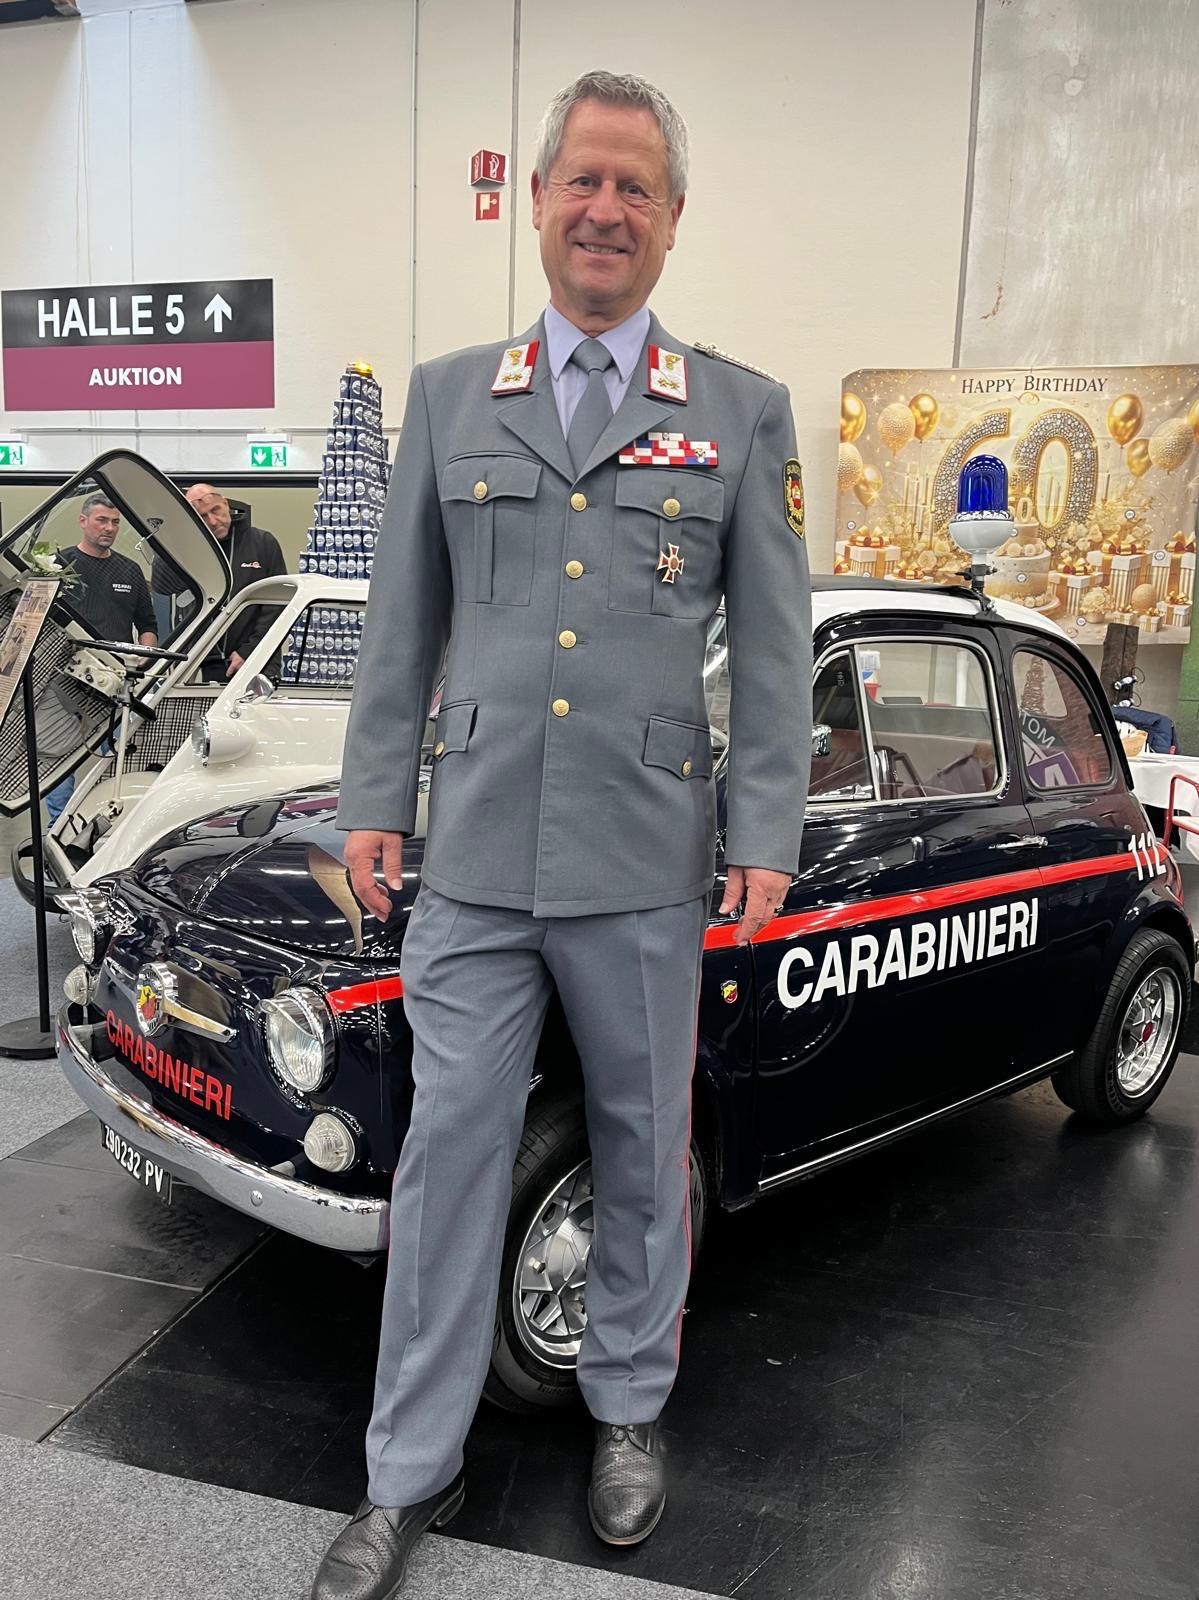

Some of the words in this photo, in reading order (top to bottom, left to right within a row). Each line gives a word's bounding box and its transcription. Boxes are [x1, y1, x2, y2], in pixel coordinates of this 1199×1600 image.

[37, 294, 154, 338] HALLE
[164, 294, 185, 335] 5
[88, 366, 182, 387] AUKTION
[962, 378, 1015, 393] HAPPY
[1024, 376, 1108, 392] BIRTHDAY
[1018, 709, 1056, 748] TOM
[1128, 831, 1167, 881] 112
[777, 897, 1039, 1010] CARABINIERI
[105, 1008, 233, 1121] CARABINIERI
[145, 1159, 164, 1193] PV
